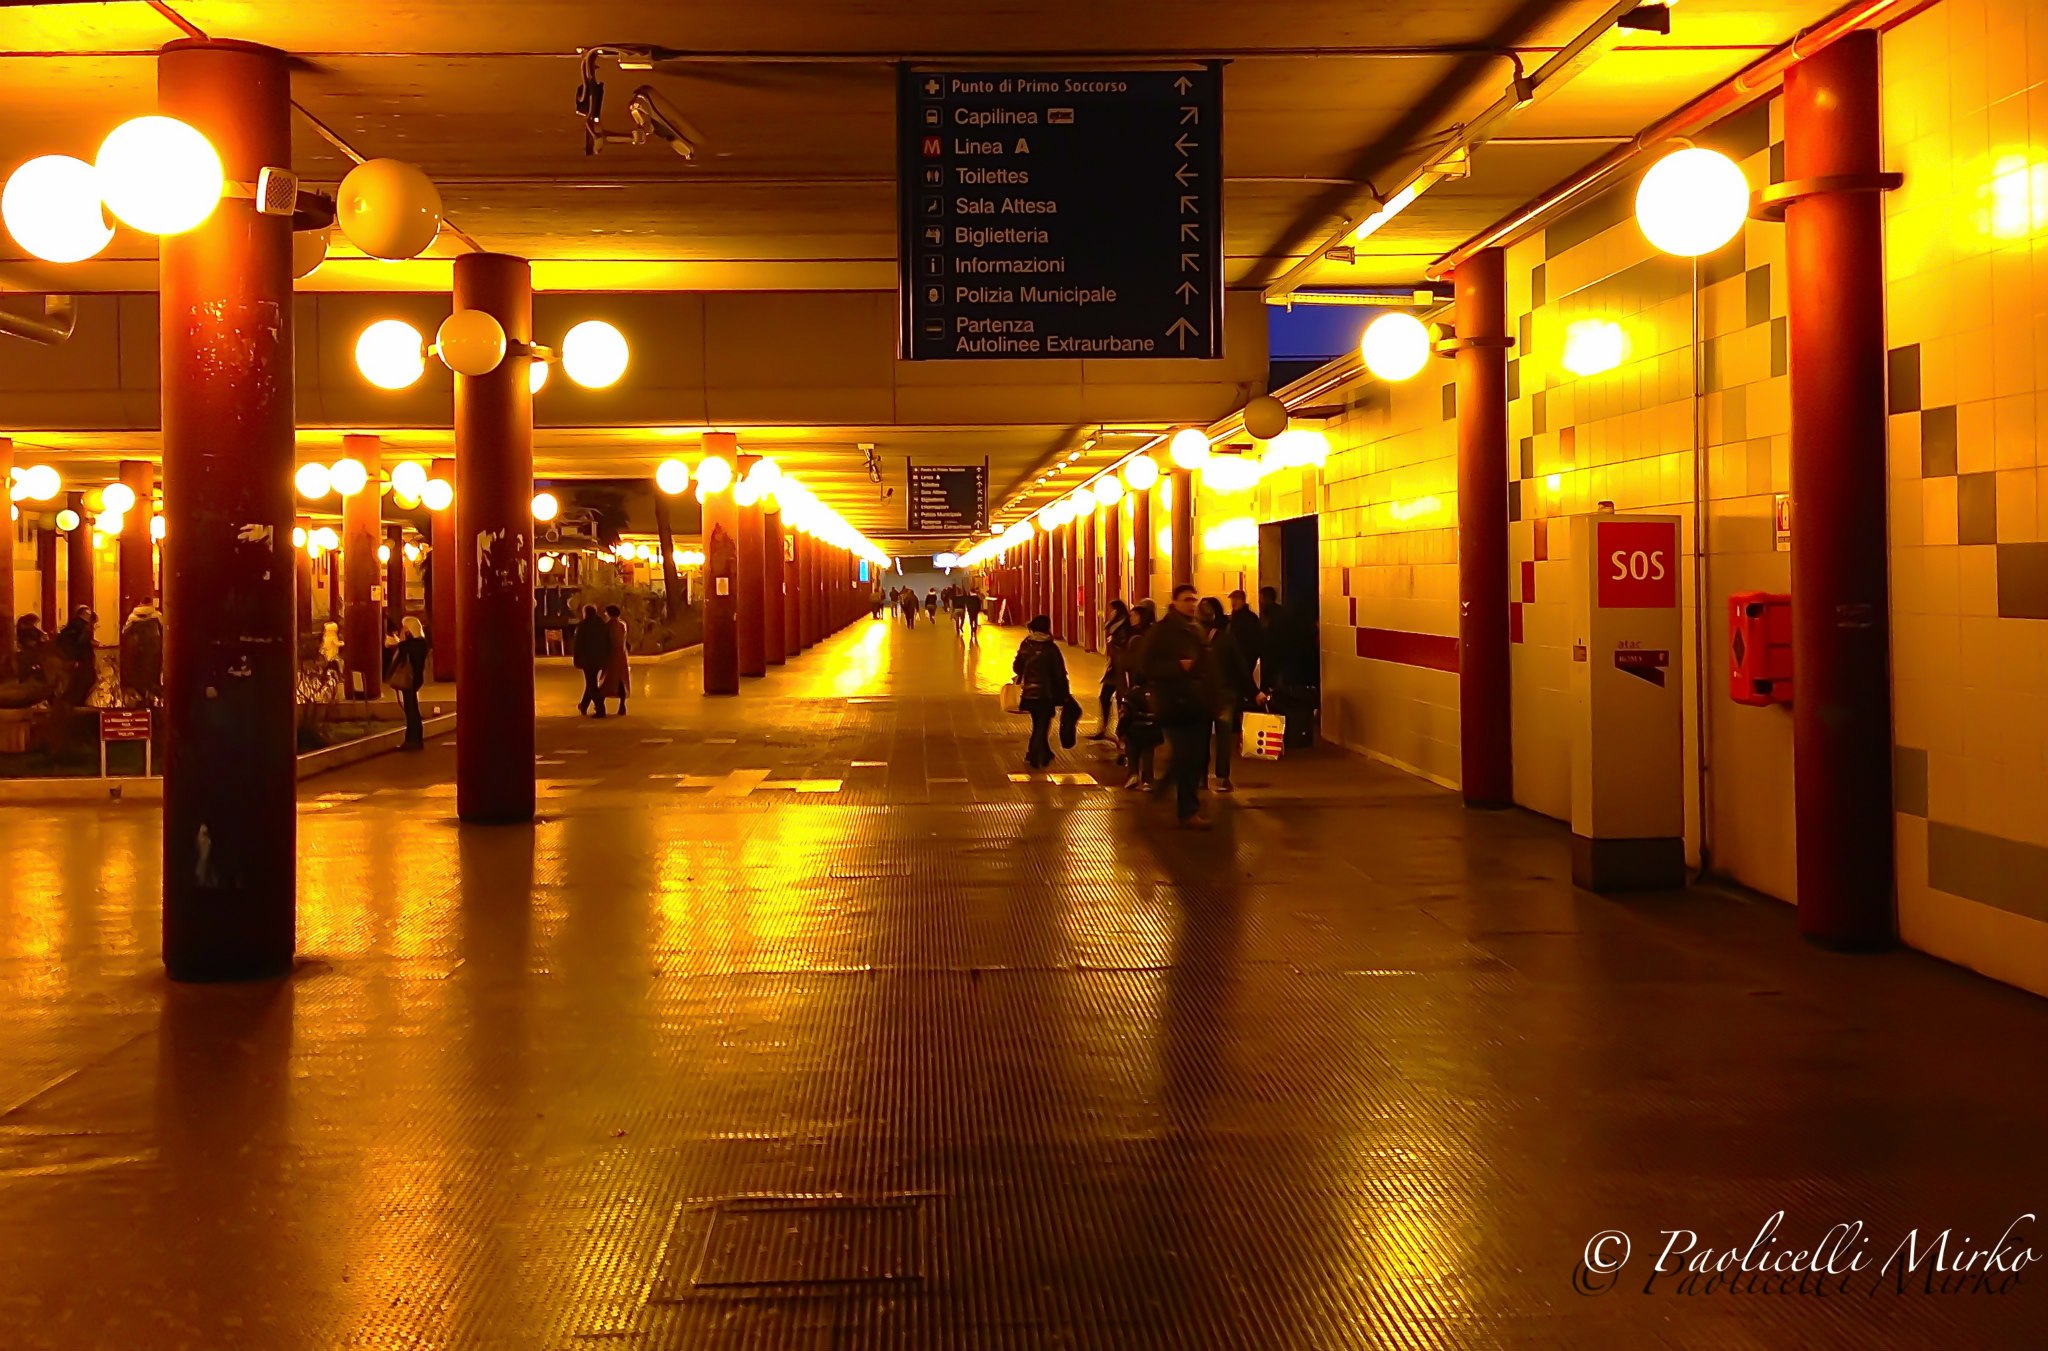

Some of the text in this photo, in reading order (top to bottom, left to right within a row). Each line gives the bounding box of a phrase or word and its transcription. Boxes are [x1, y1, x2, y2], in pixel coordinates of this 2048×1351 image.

[952, 78, 1127, 93] Punto di Primo Soccorso
[954, 108, 1038, 127] Capilinea
[954, 138, 1003, 154] Linea
[1014, 138, 1030, 154] A
[956, 167, 1029, 184] Toilettes
[956, 197, 1057, 214] Sala Attesa
[955, 227, 1049, 247] Biglietteria
[955, 256, 1065, 273] Informazioni
[956, 286, 1117, 306] Polizia Municipale
[956, 317, 1034, 333] Partenza
[956, 335, 1154, 352] Autolinee Extraurbane
[1611, 550, 1665, 581] SOS
[1617, 639, 1642, 649] atac
